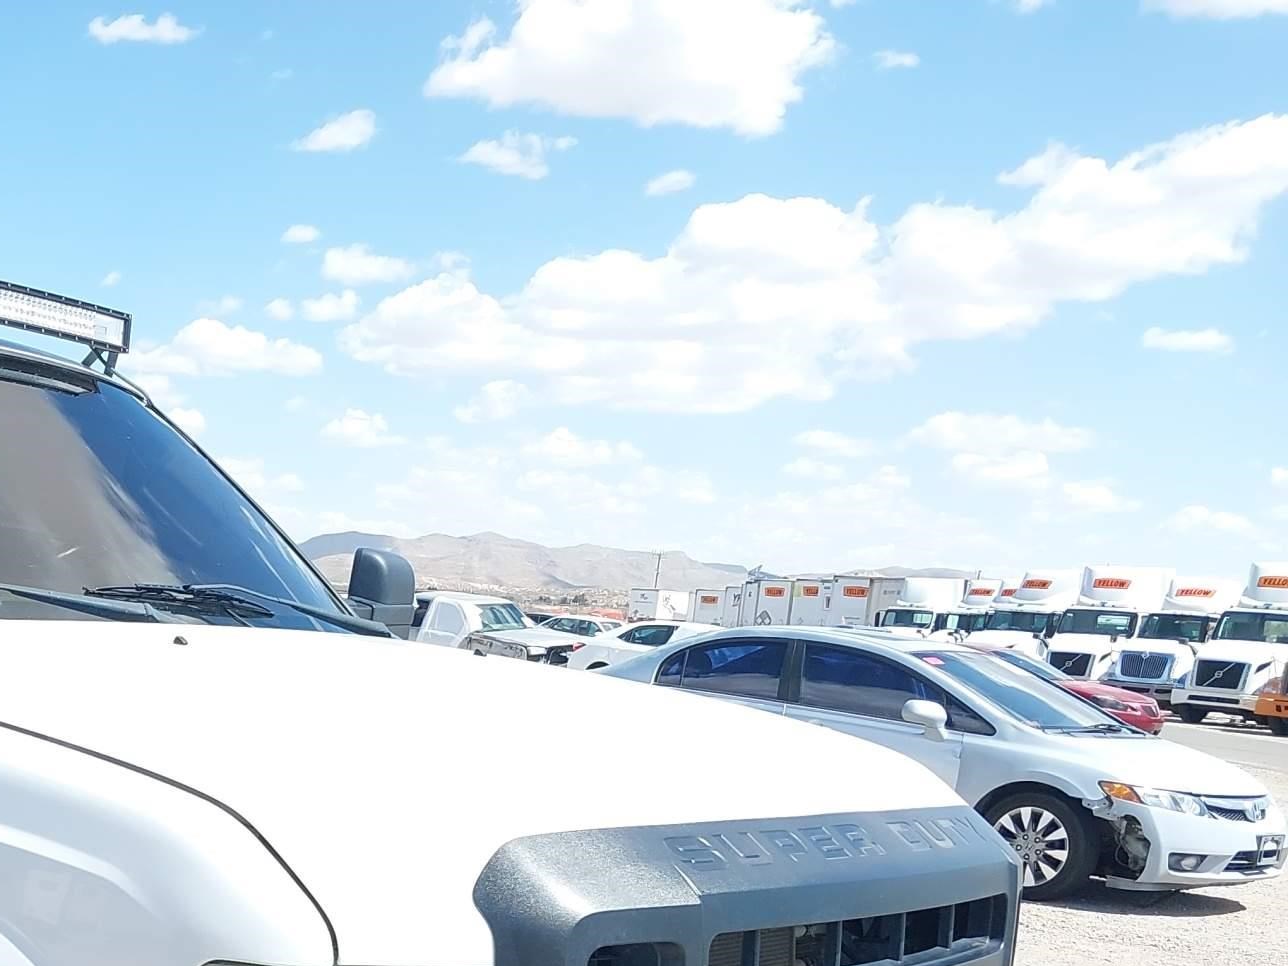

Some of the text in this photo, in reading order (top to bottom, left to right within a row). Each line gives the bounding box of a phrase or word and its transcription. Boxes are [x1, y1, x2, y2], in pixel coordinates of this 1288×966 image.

[1097, 579, 1127, 588] YELLOW
[1263, 577, 1288, 587] YELLO
[1180, 588, 1212, 597] YELLOW
[663, 816, 990, 871] SUPER DUTY
